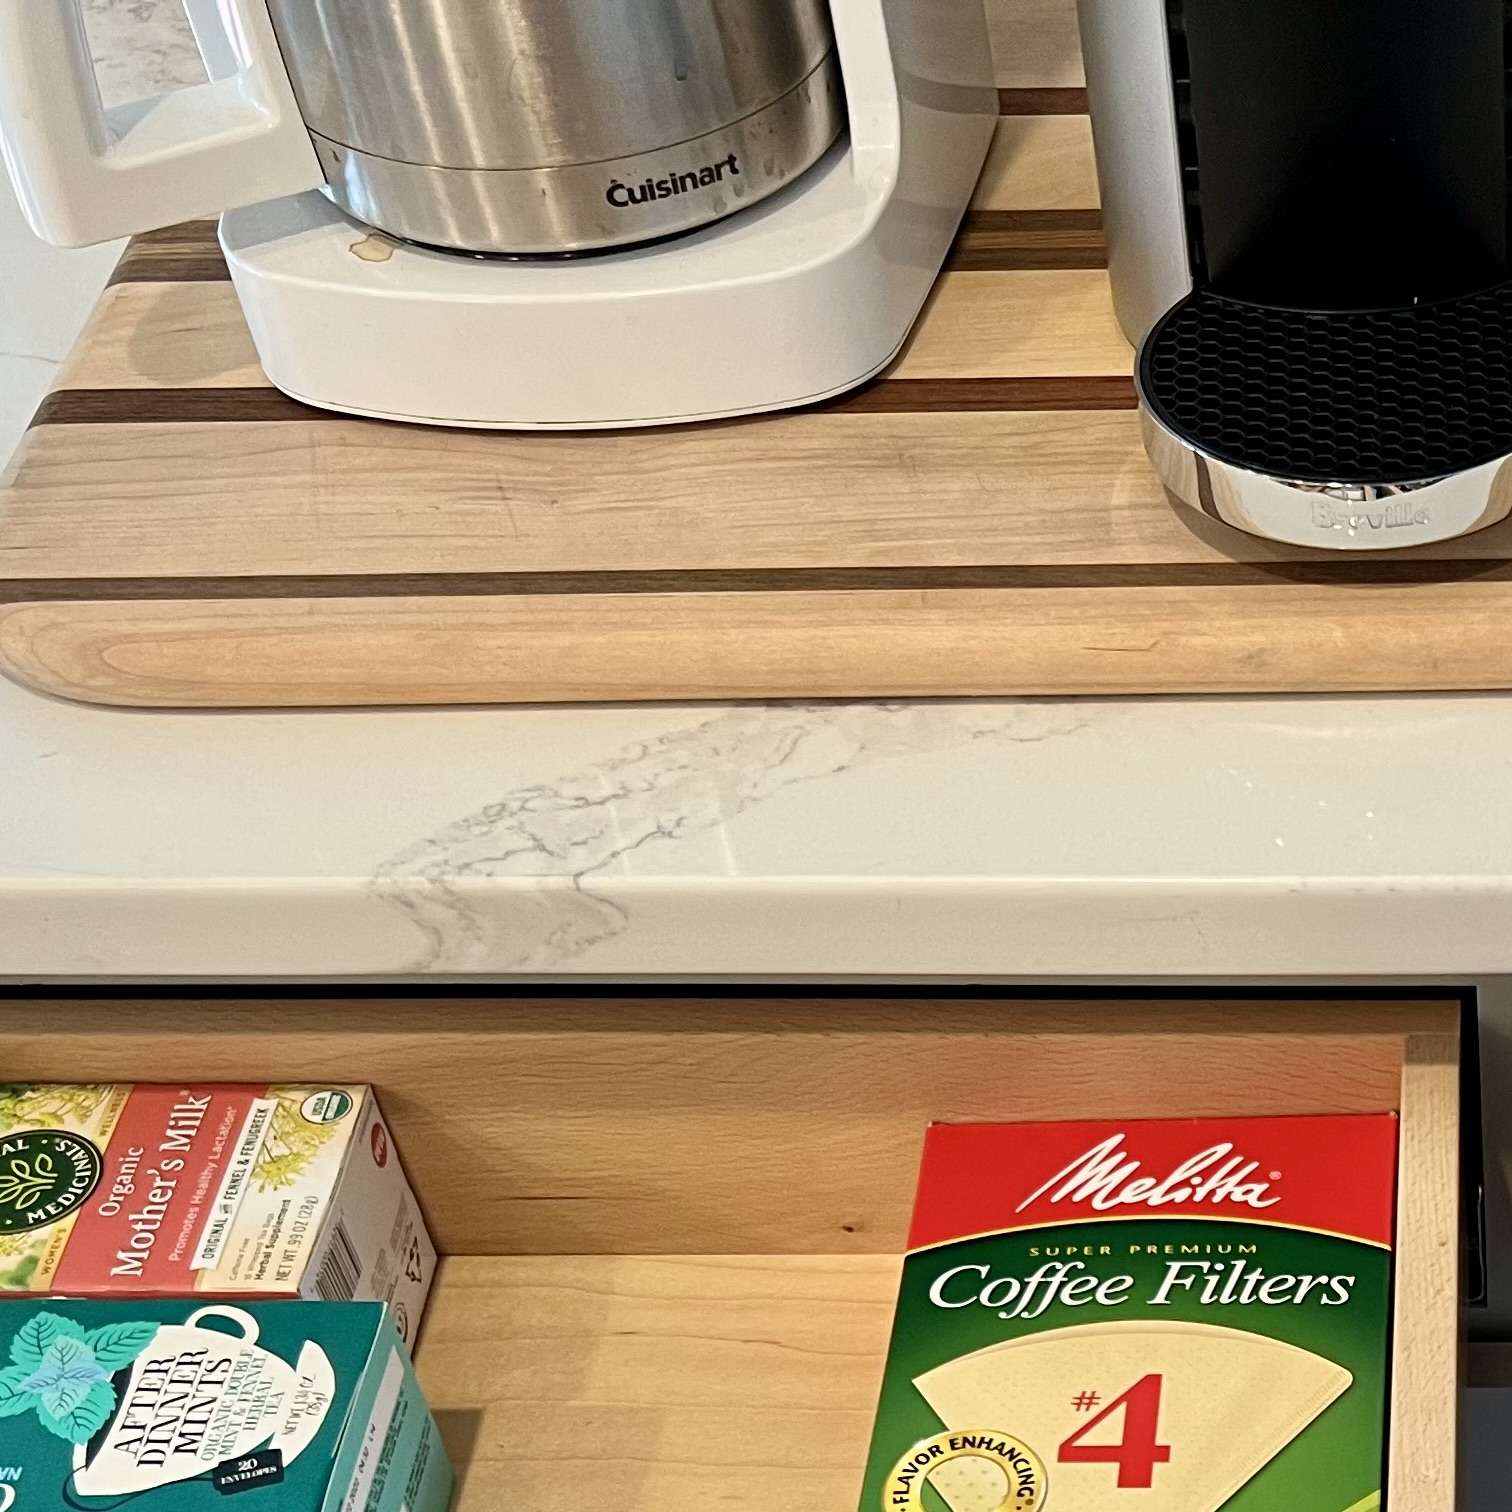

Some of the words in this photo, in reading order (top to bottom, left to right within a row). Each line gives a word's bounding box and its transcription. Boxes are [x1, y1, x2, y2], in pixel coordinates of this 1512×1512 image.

[605, 154, 740, 208] Cuisinart
[242, 1107, 270, 1158] FENUGREEK
[27, 1139, 92, 1224] MEDICINALS
[98, 1147, 144, 1217] Organic
[224, 1169, 246, 1200] FENNEL
[237, 1158, 250, 1169] &
[1015, 1132, 1281, 1214] Melitta
[110, 1157, 185, 1277] Mother's
[168, 1205, 200, 1262] Promotes
[193, 1160, 218, 1202] Healthy
[201, 1218, 228, 1259] ORIGINAL
[254, 1250, 272, 1281] Herbal
[1029, 1246, 1111, 1257] SUPER
[1129, 1244, 1259, 1256] PREMIUM
[275, 1261, 293, 1282] NET
[928, 1261, 1134, 1320] Coffee
[1146, 1258, 1357, 1306] Filters
[114, 1356, 176, 1459] AFTER
[136, 1348, 208, 1467] DINNER
[173, 1358, 232, 1456] MINTS
[201, 1400, 233, 1461] ORGANIC
[243, 1377, 275, 1431] HERBAL
[263, 1392, 285, 1418] TEA
[218, 1420, 242, 1455] MINT
[220, 1465, 278, 1485] ENVELOPES
[237, 1458, 258, 1472] 20
[893, 1444, 944, 1505] FLAVOR
[949, 1435, 1035, 1499] ENHANCING
